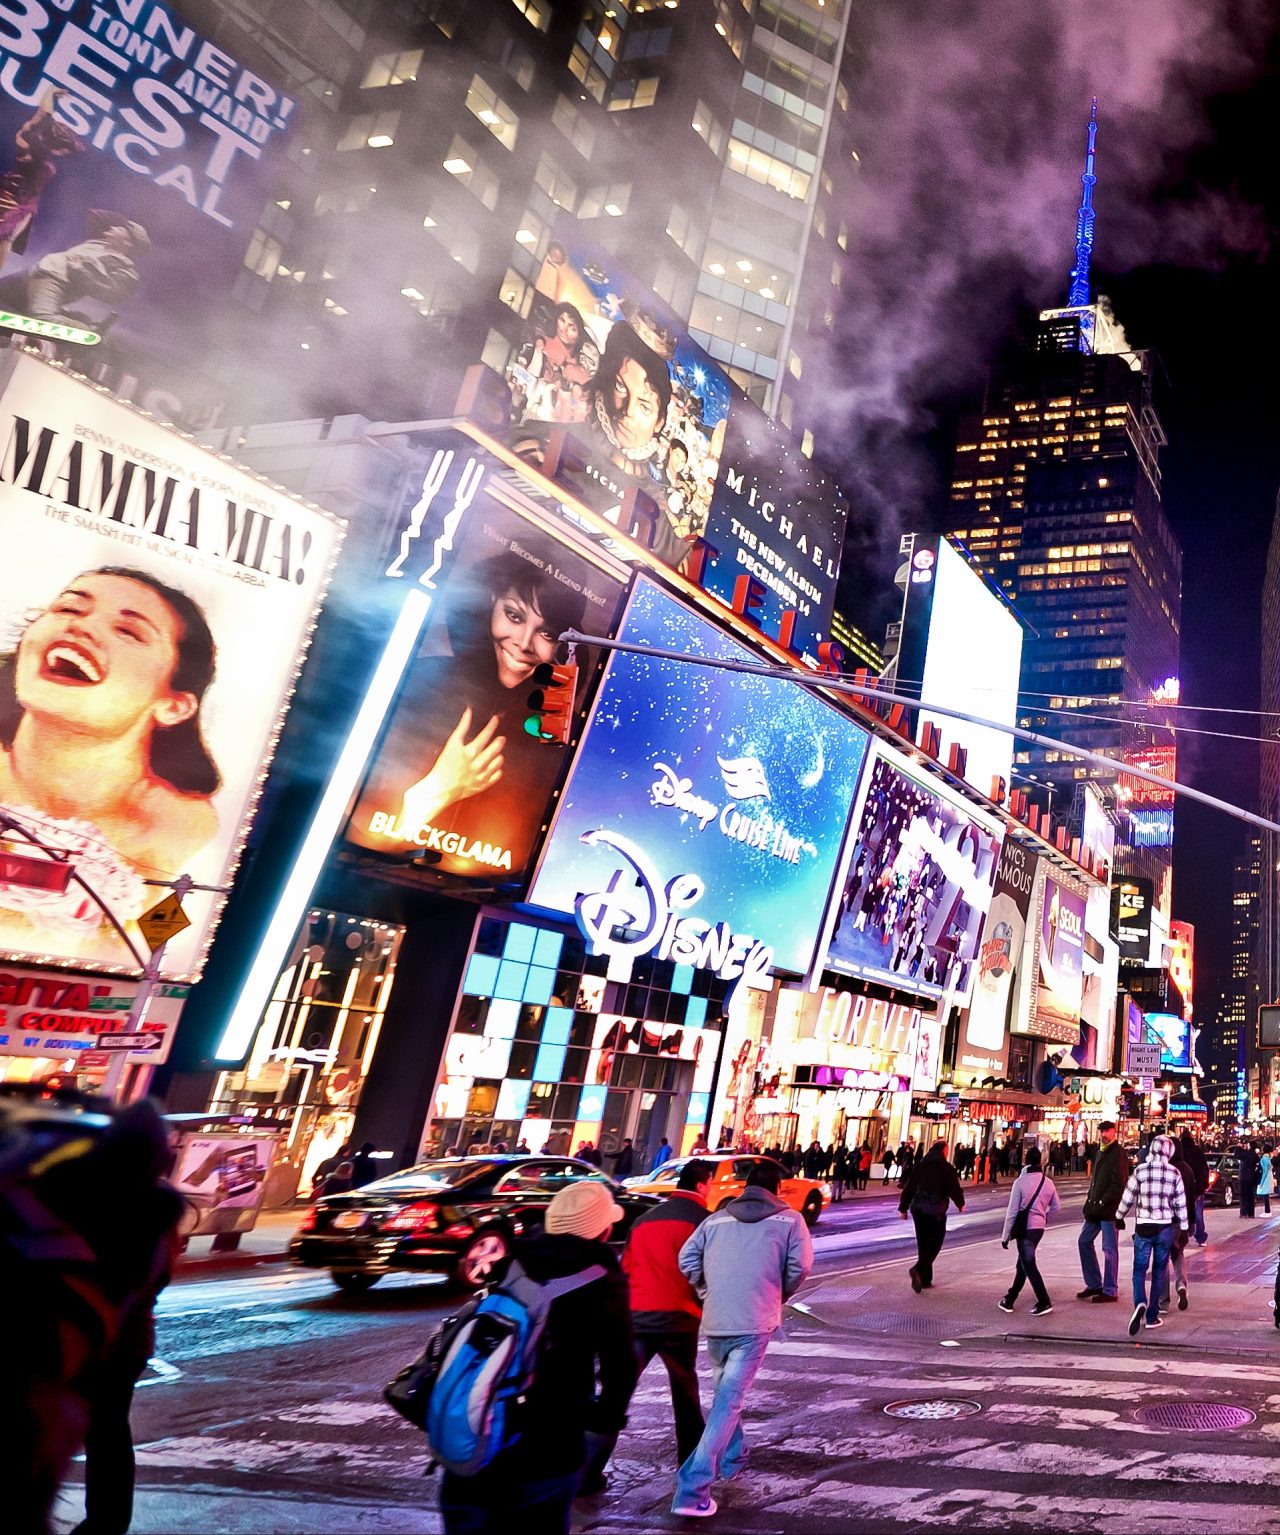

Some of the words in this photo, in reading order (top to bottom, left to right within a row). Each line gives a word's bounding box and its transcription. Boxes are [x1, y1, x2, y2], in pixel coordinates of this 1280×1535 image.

[0, 0, 262, 184] BEST
[89, 8, 172, 74] TONY
[174, 70, 276, 144] AWARD
[0, 414, 200, 550] MAMMA
[213, 499, 312, 586] MIA!
[725, 467, 836, 580] MICHAEL
[730, 516, 757, 550] THE
[758, 543, 783, 572] NEW
[784, 563, 822, 605] ALBUM
[736, 547, 799, 608] DECEMBER
[798, 599, 811, 618] 14
[368, 810, 512, 871] BLACKGLAMA
[1004, 842, 1026, 868] NYC's
[1059, 905, 1083, 938] SEOUL
[105, 1037, 126, 1046] ONE
[813, 985, 922, 1055] FOREVER
[1136, 1056, 1154, 1064] MUST
[970, 1101, 1002, 1121] PLANET
